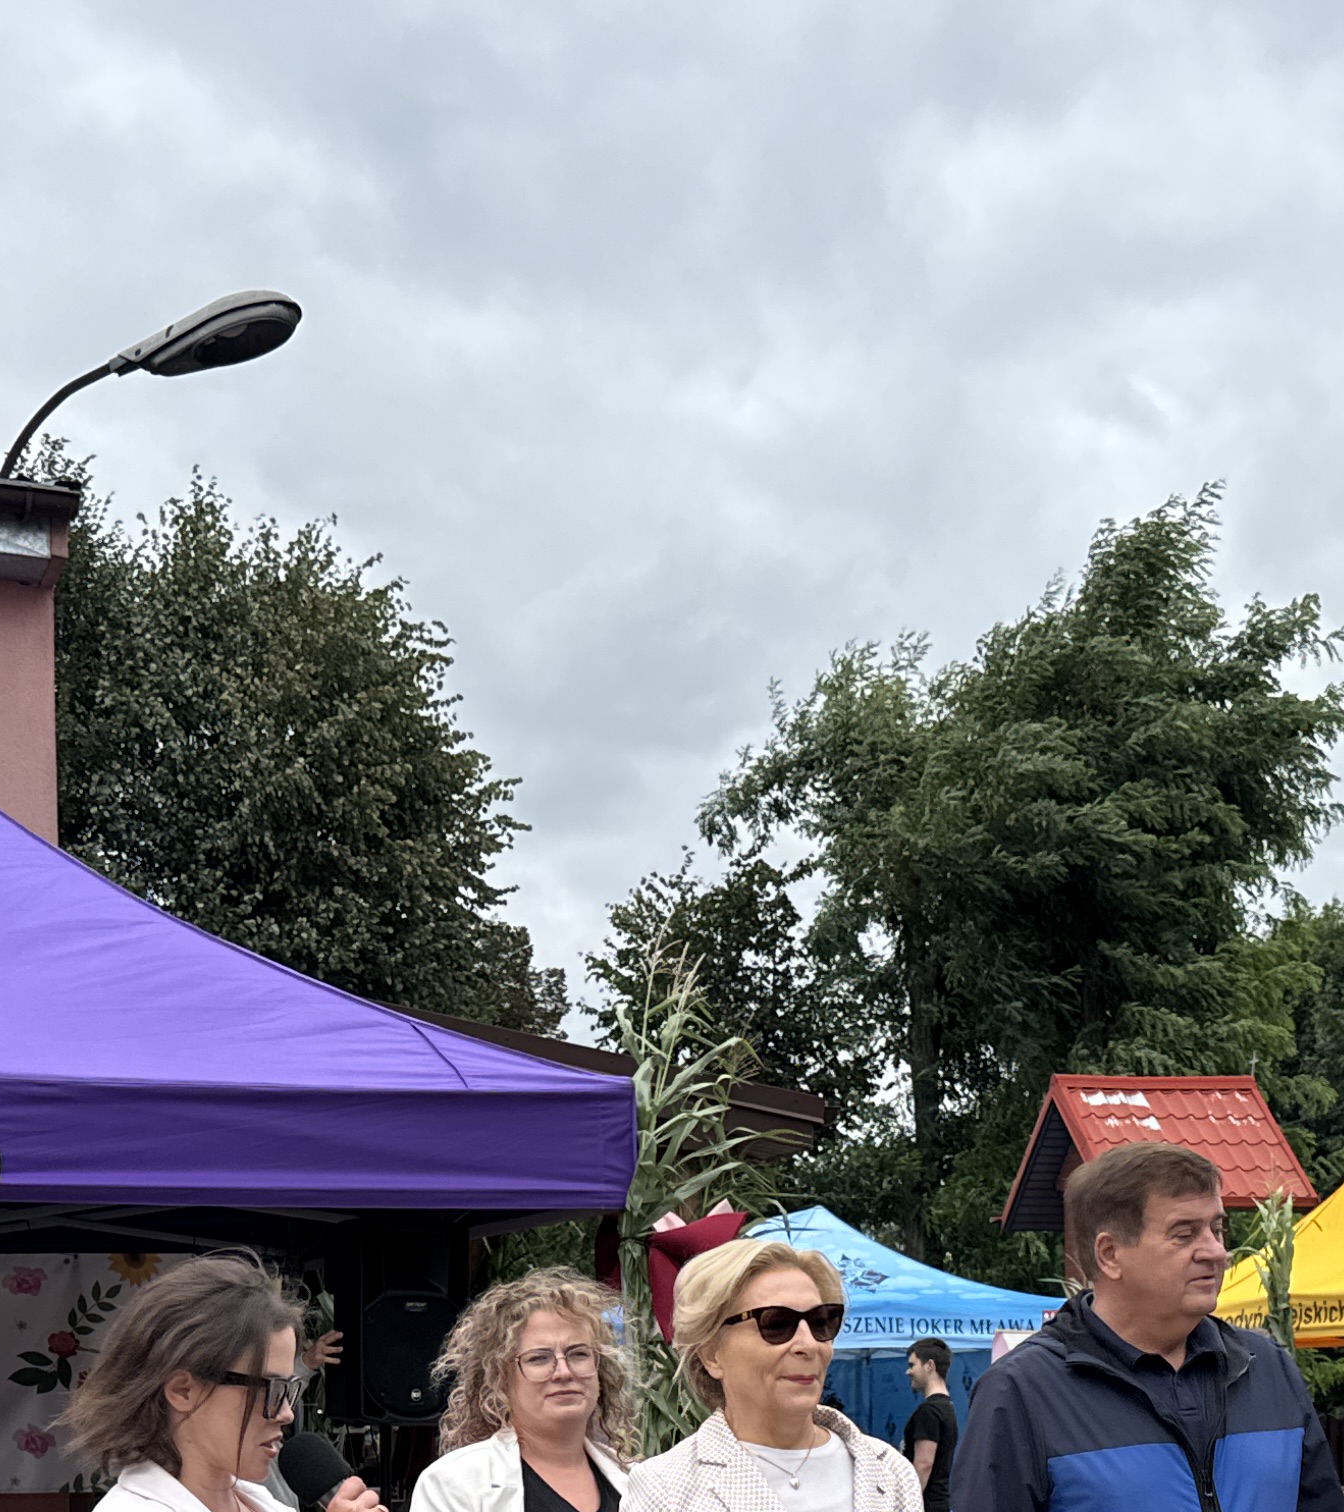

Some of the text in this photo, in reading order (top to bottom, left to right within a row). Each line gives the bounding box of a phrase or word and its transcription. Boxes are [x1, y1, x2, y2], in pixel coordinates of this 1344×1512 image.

[842, 1317, 1035, 1337] SZENIE JOKER MŁAWA
[1223, 1306, 1263, 1329] odyń
